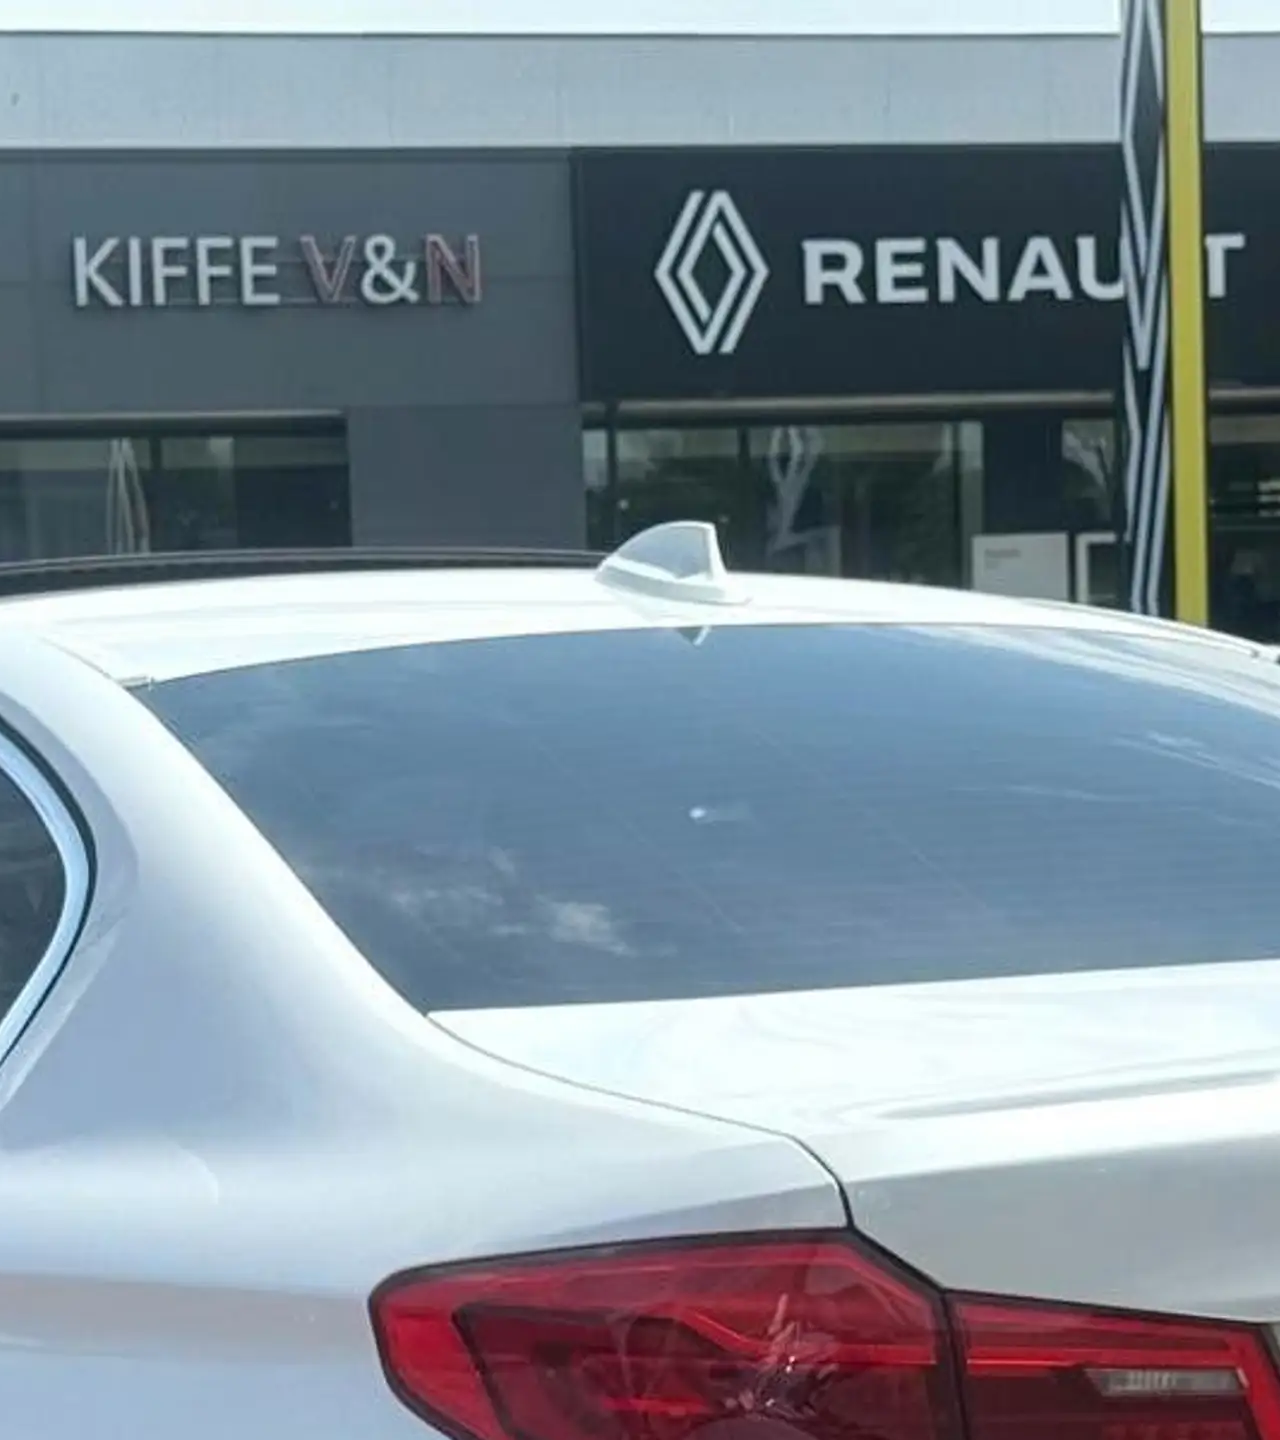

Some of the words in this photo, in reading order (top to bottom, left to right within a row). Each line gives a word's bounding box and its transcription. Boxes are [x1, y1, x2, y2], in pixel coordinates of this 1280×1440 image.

[72, 235, 281, 308] KIFFE
[300, 234, 483, 304] V&N
[802, 233, 1246, 304] RENAUT
